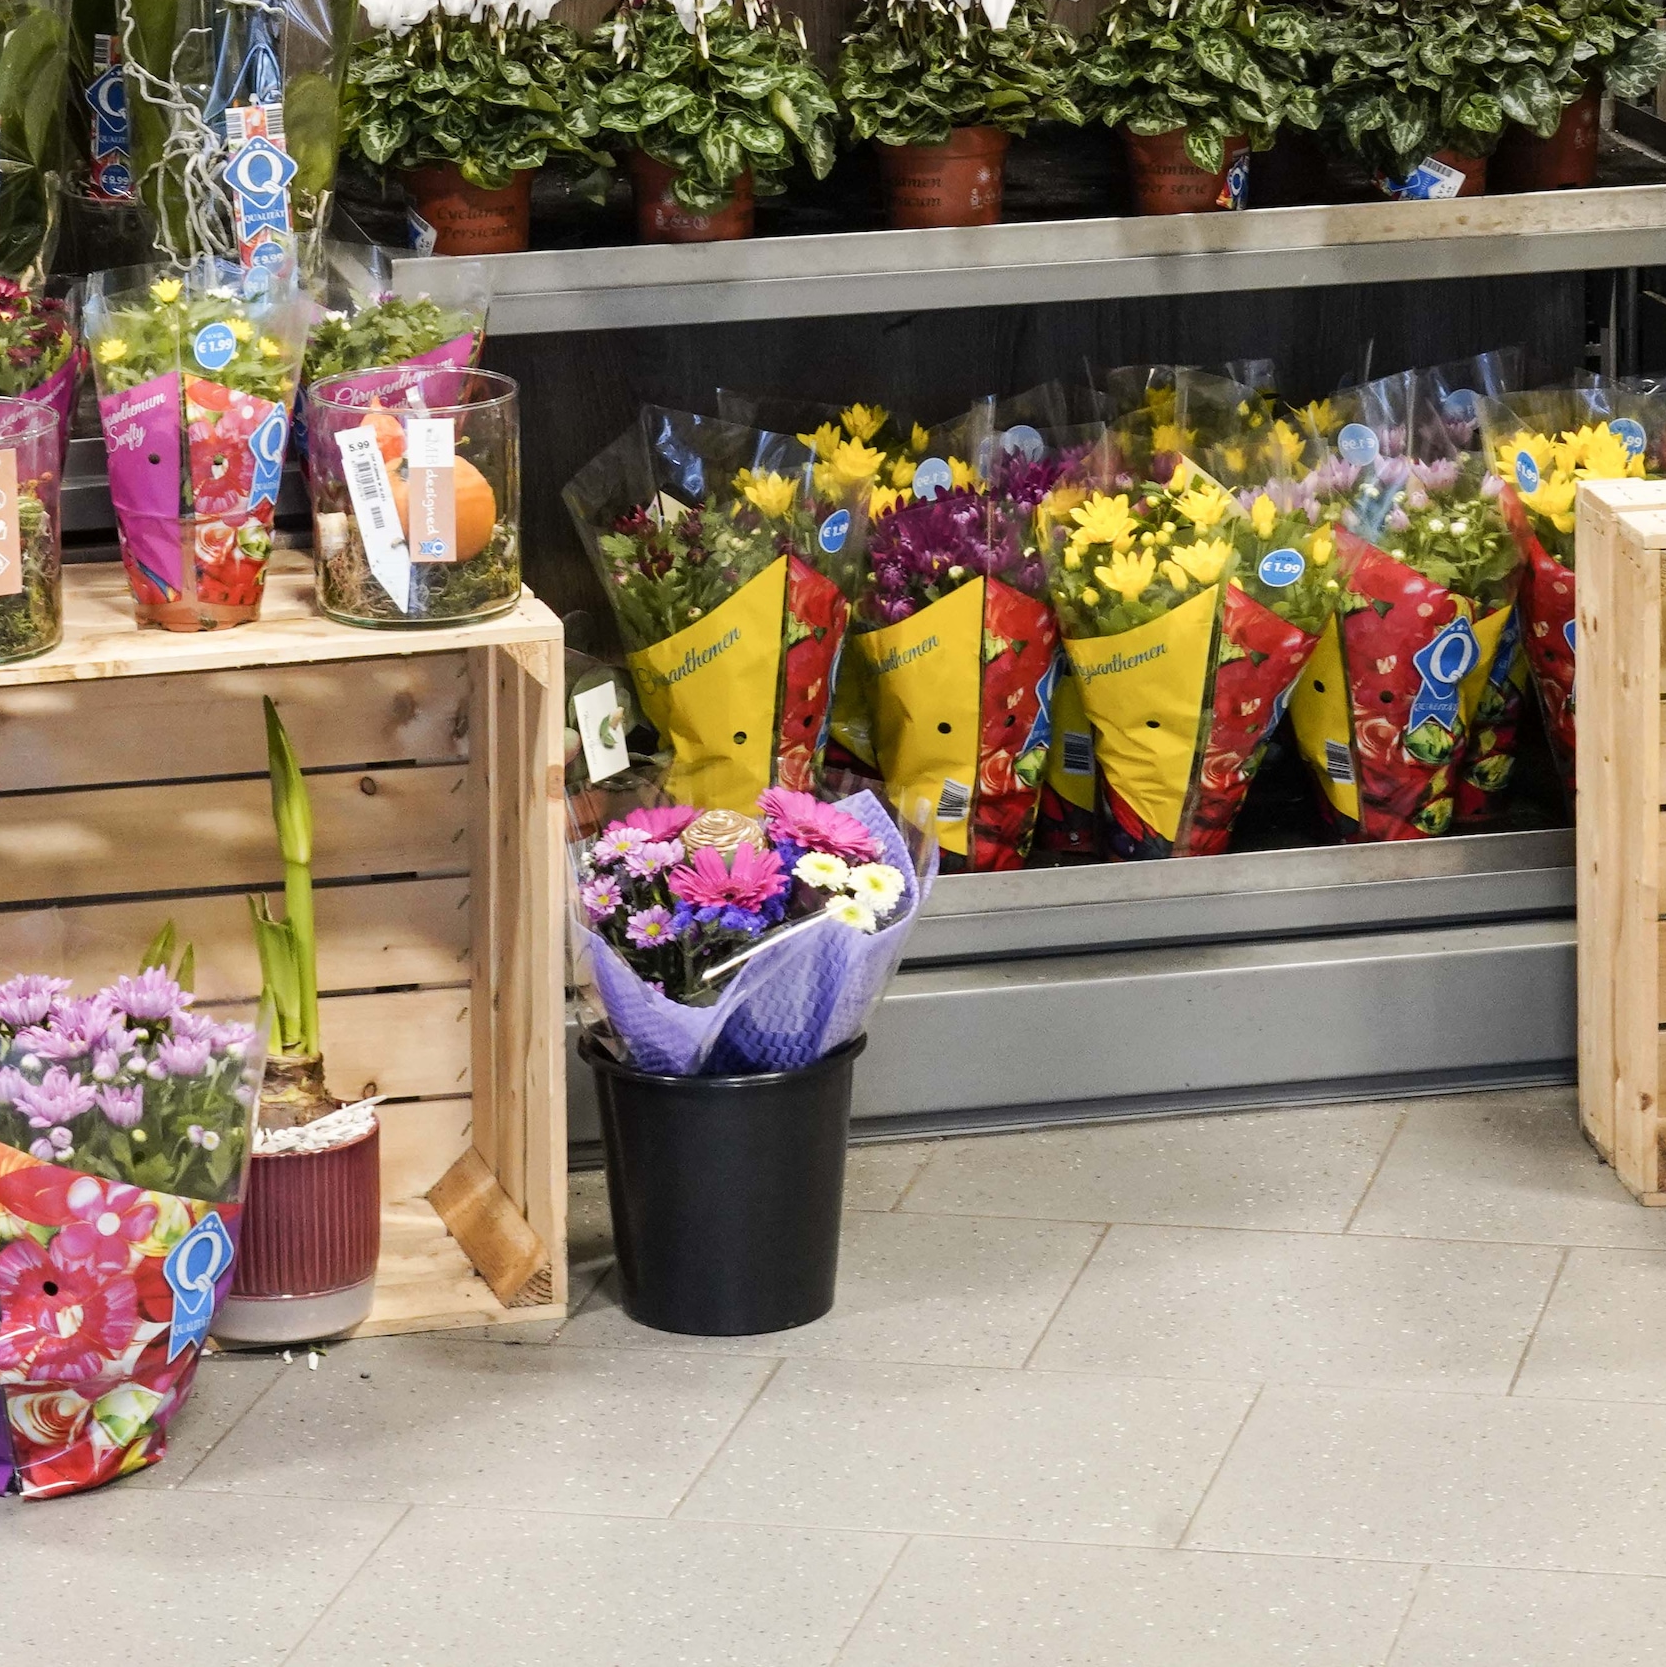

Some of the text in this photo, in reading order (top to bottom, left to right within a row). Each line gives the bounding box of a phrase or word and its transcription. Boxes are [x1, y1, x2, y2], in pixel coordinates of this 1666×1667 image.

[236, 149, 284, 195] Q
[244, 208, 287, 224] QUALITÄT
[197, 338, 233, 354] €1.99
[258, 415, 287, 464] Q
[347, 439, 371, 453] 5.99
[421, 468, 437, 537] designed
[1262, 560, 1303, 576] €1.99
[1429, 631, 1475, 687] Q
[175, 1221, 234, 1295] Q
